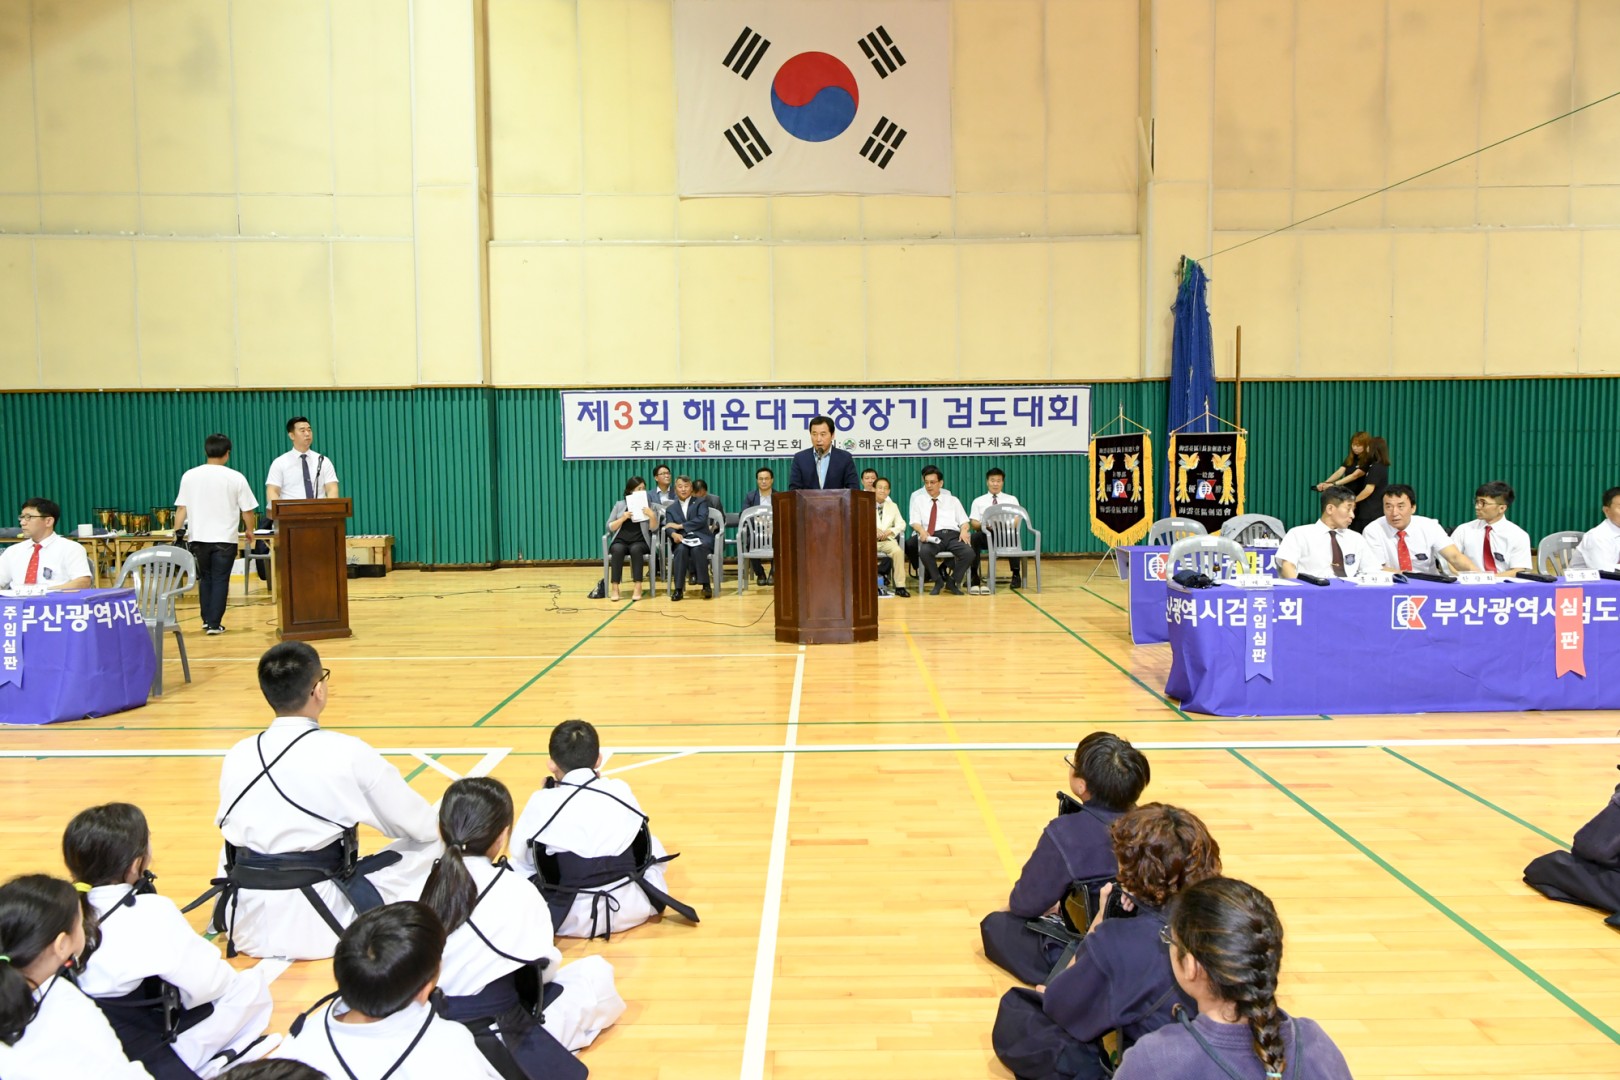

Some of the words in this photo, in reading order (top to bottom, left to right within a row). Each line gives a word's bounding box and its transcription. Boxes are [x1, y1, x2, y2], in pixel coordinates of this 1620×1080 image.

[577, 398, 669, 432] 제3회
[682, 397, 928, 432] 해운대구청장기
[943, 394, 1078, 428] 검도대회
[708, 439, 802, 453] 해운대구검도회
[858, 438, 912, 451] 해운대구
[933, 436, 1027, 449] 해운대구체육회
[3, 605, 18, 670] 주임심판
[1251, 597, 1268, 663] 주임심판
